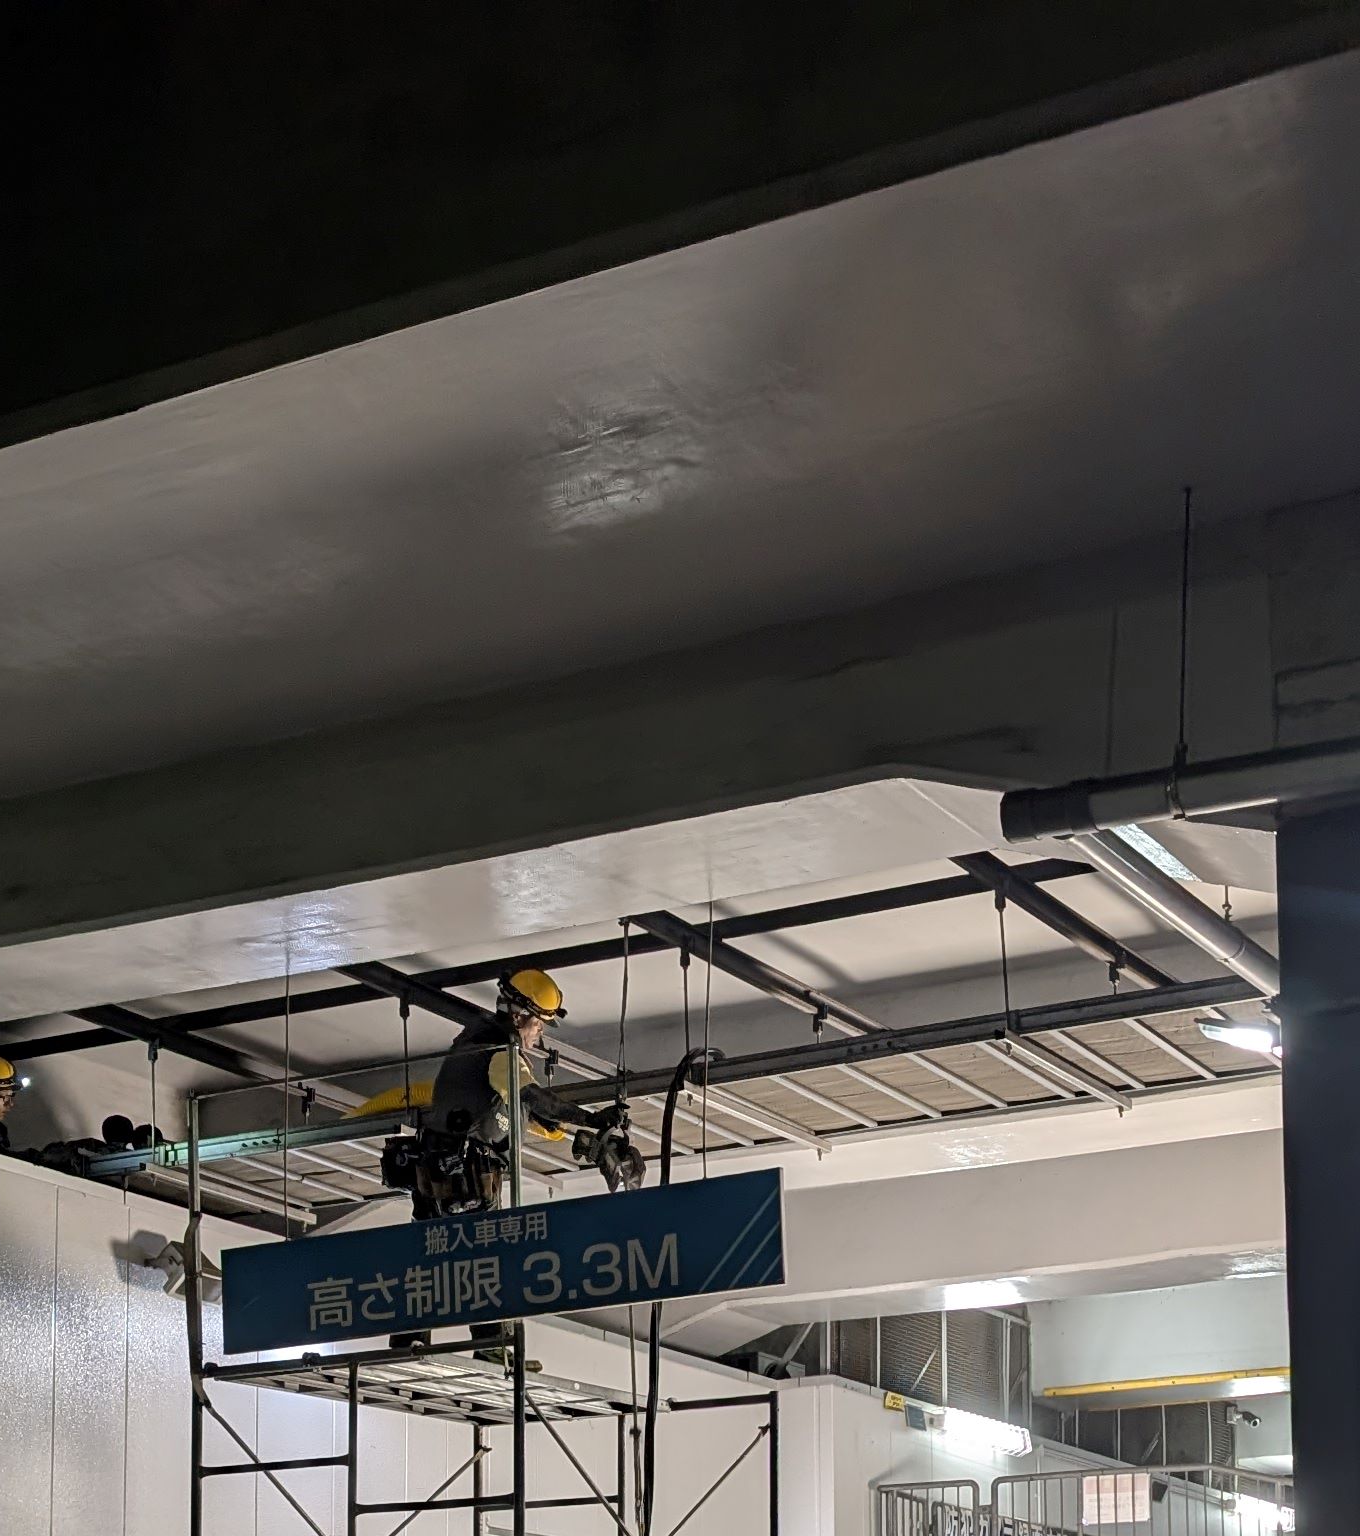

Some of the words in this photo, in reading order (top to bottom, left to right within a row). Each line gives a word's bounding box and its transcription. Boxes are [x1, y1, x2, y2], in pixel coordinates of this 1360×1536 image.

[424, 1211, 549, 1256] 搬入車専用
[307, 1255, 503, 1331] 高さ制限
[522, 1233, 680, 1305] 3.3M
